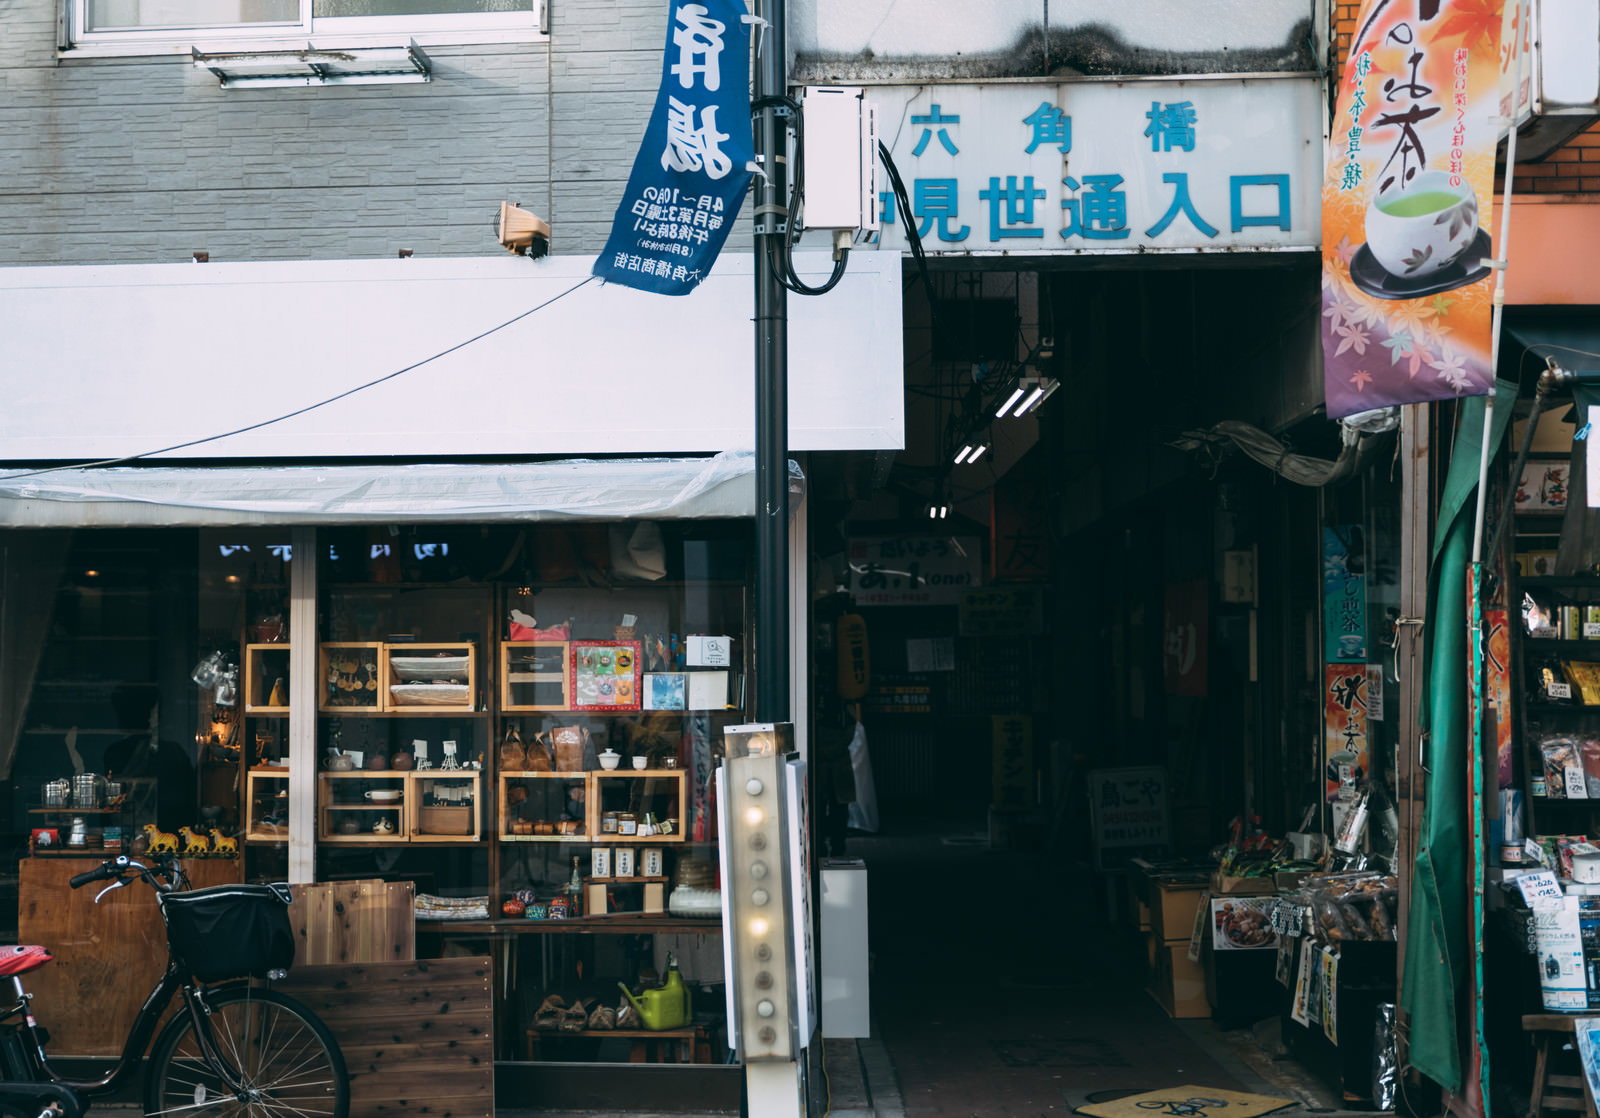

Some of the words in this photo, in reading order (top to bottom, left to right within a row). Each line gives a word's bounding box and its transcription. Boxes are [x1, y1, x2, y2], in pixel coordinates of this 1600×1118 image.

[910, 101, 1198, 157] 六角橋
[879, 172, 1292, 242] 見世通入口
